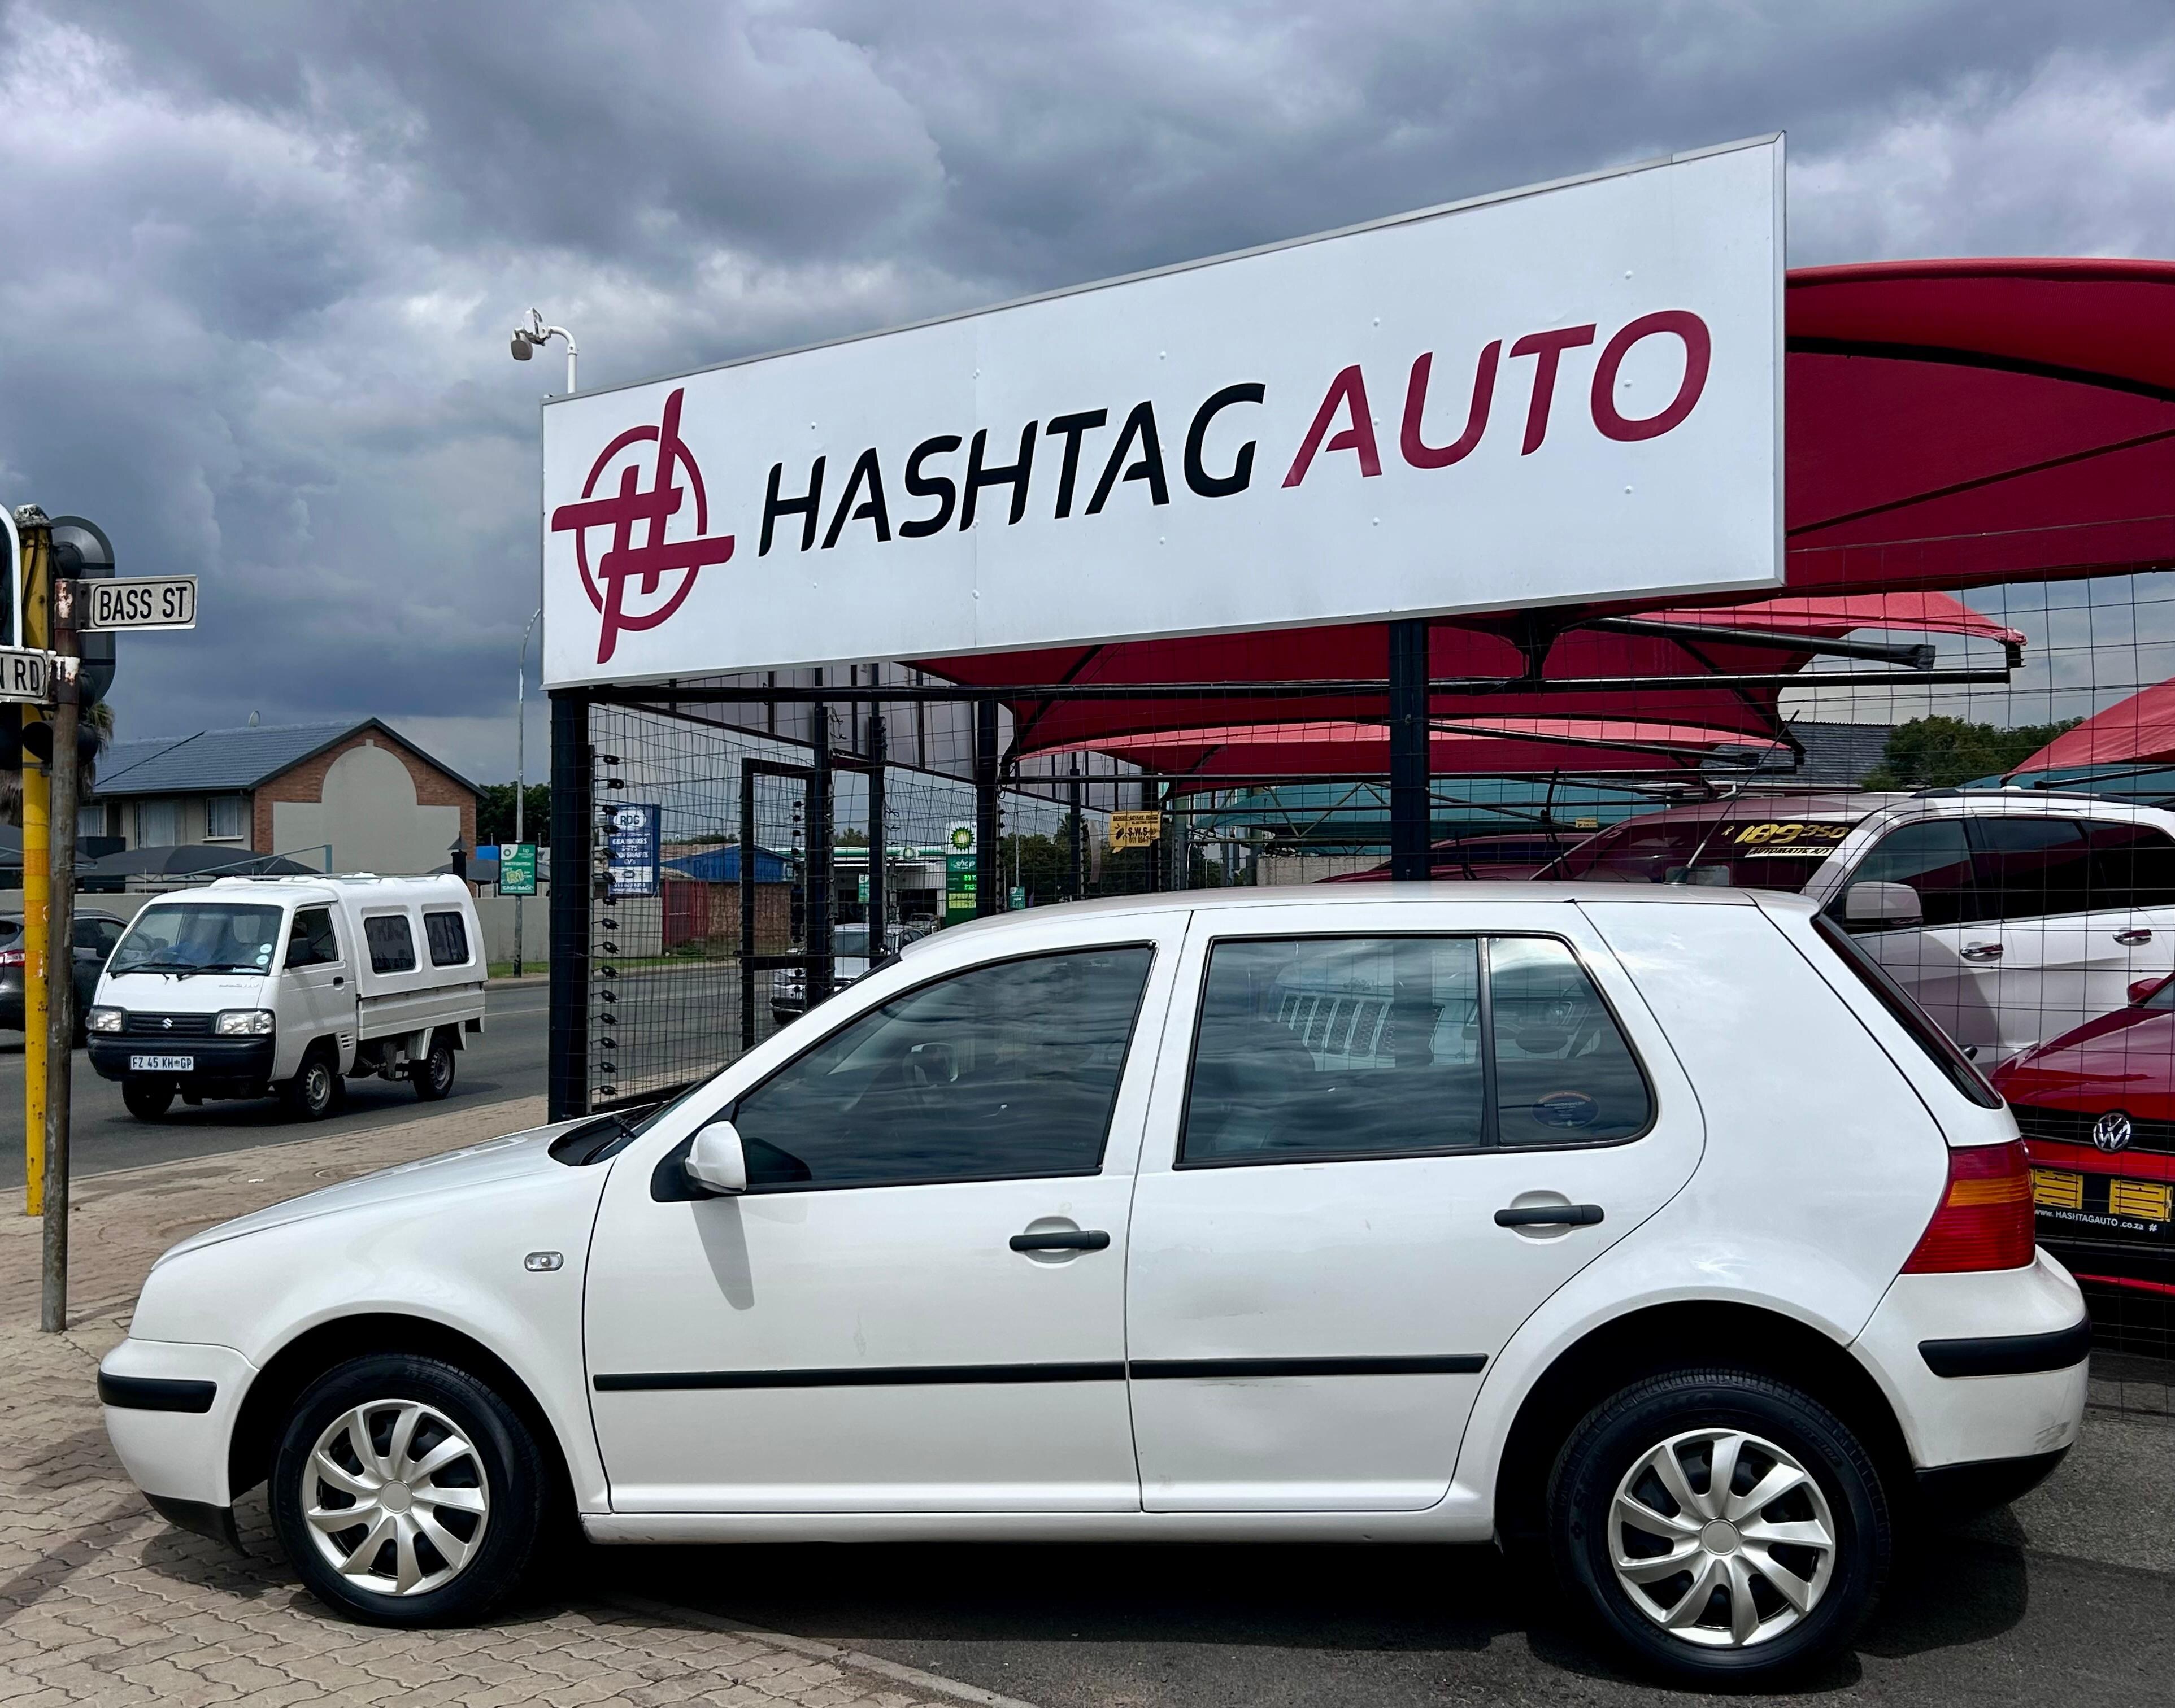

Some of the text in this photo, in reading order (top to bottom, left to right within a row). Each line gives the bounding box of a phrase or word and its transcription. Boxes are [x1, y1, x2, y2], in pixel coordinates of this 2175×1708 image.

[759, 311, 1711, 556] HASHTAG AUTO
[99, 586, 188, 621] BASS ST
[14, 659, 40, 691] RD
[620, 815, 640, 825] RDG
[132, 1057, 192, 1069] FZ 45 KH GP
